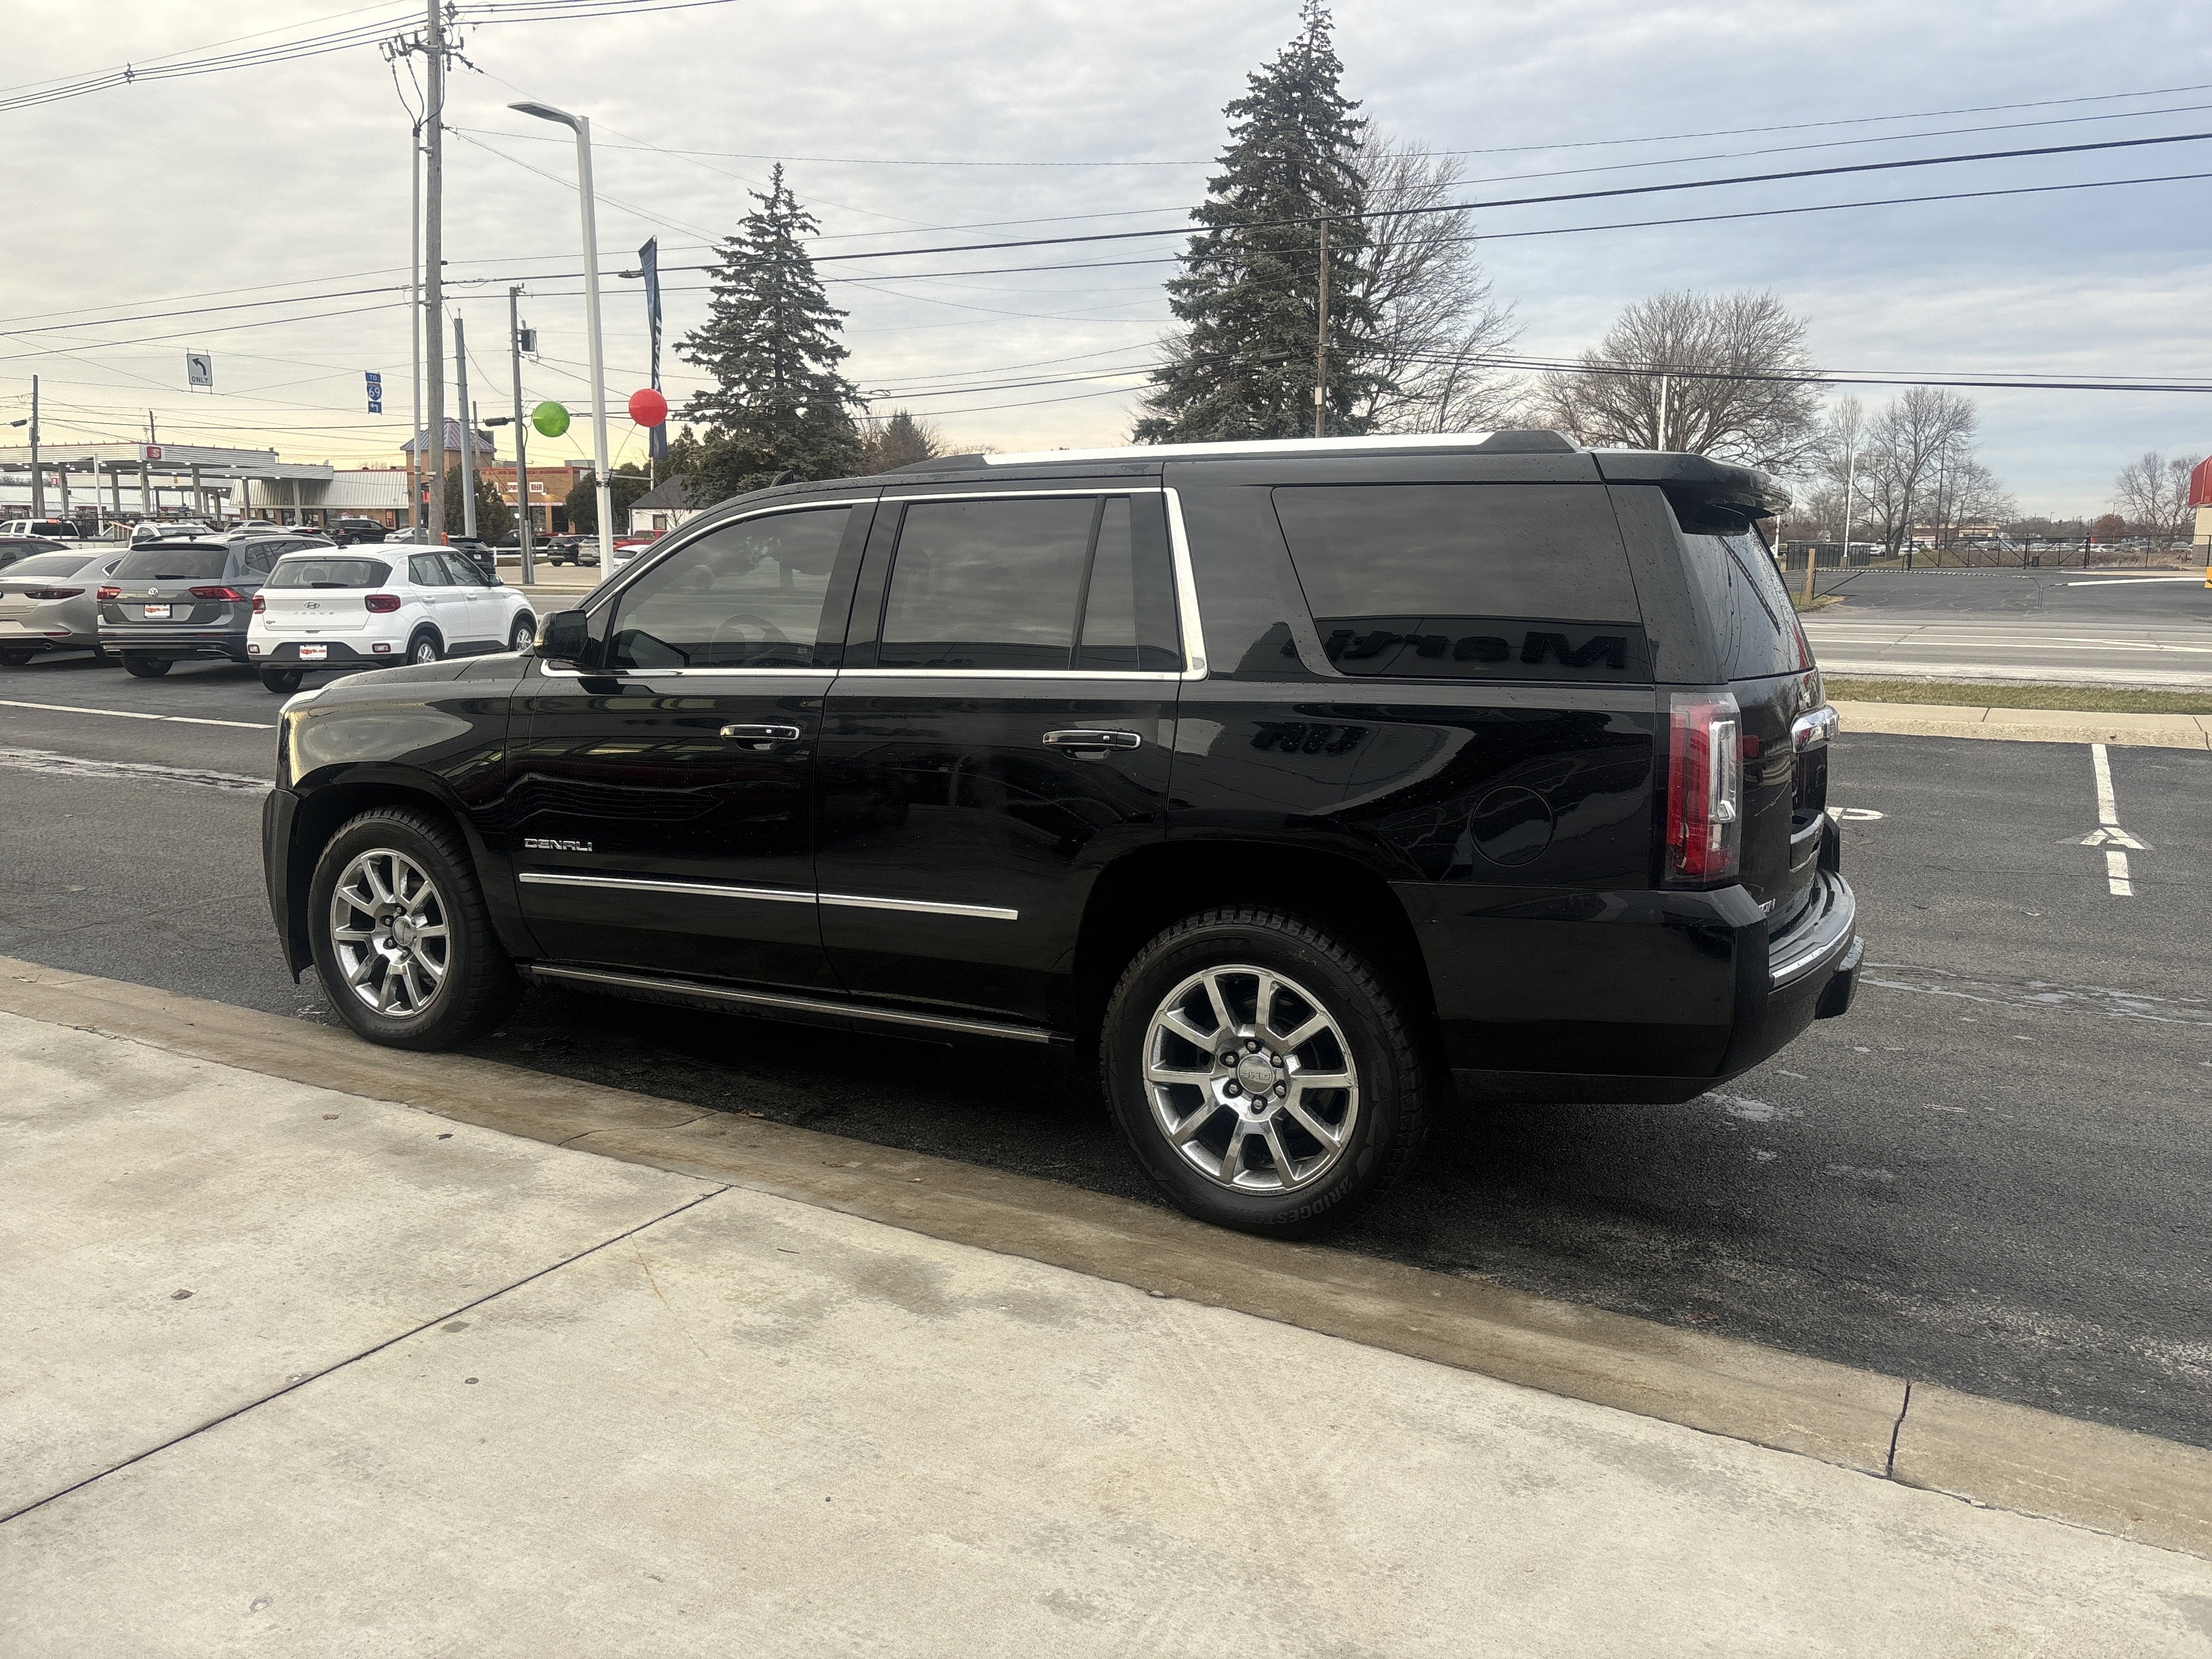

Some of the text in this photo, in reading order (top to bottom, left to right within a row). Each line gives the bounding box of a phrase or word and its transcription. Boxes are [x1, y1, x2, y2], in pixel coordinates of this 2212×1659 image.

[369, 387, 380, 397] 69
[524, 838, 593, 851] DENALI
[1240, 1070, 1271, 1080] GMC
